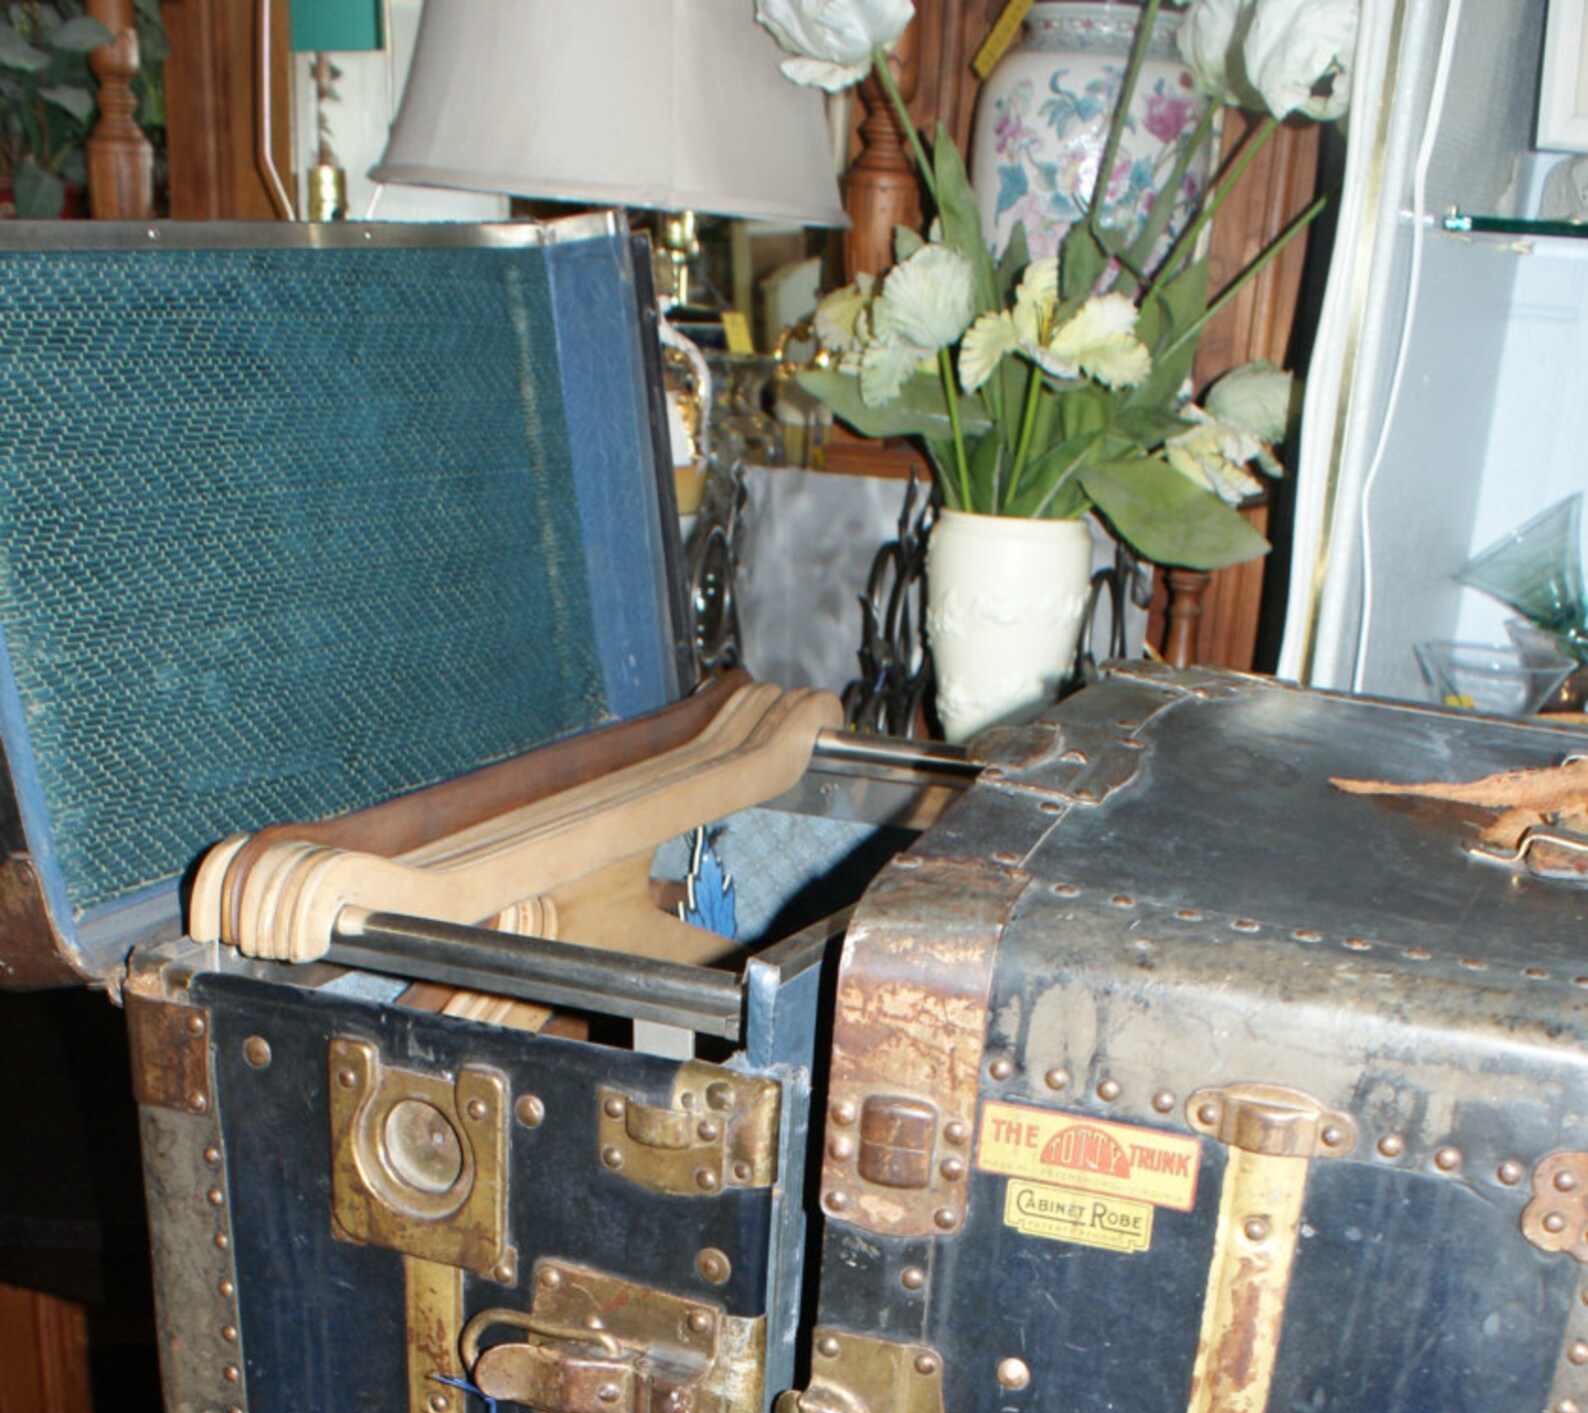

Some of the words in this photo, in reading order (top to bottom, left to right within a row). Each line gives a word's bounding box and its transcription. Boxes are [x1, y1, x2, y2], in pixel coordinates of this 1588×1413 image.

[992, 1118, 1040, 1149] THE
[1048, 1127, 1122, 1173] TOTTY
[1129, 1143, 1192, 1178] TRUNK
[1089, 1202, 1142, 1232] ROBE
